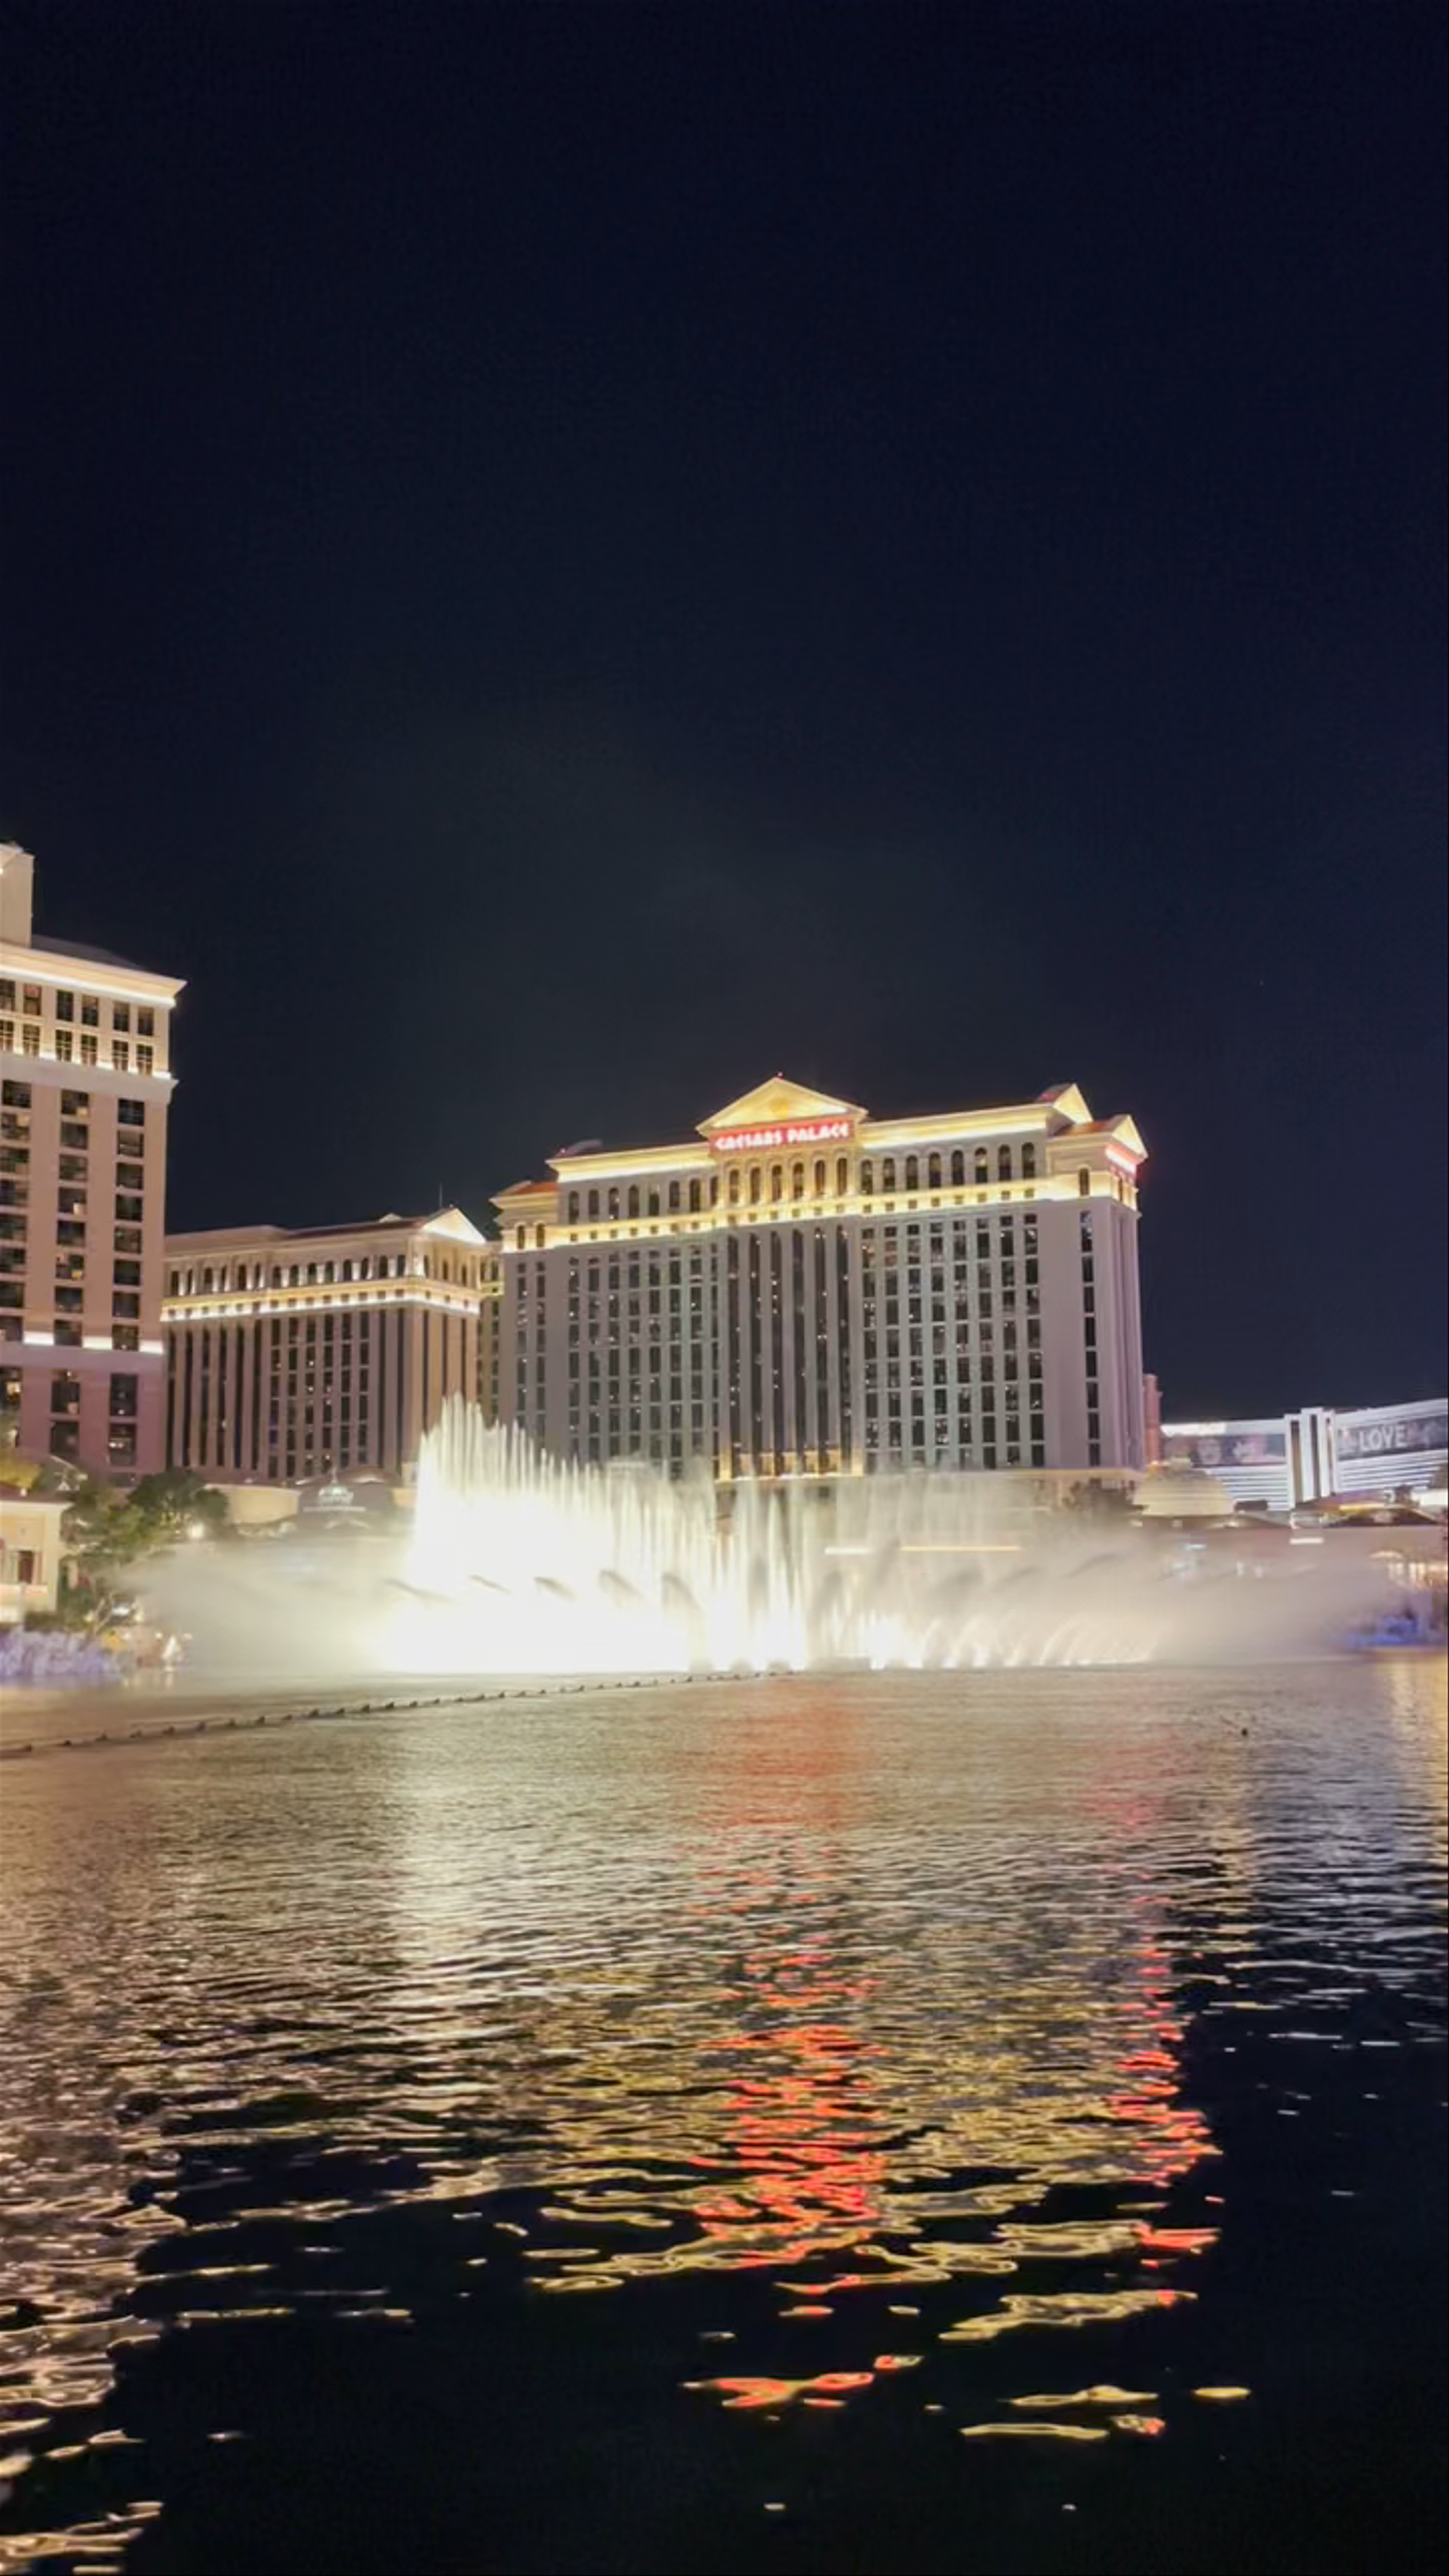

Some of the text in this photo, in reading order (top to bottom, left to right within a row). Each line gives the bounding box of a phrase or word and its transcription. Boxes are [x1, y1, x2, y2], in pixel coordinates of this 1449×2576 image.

[715, 1122, 849, 1150] CAESARS PALACE
[1360, 1424, 1406, 1451] LOVE
